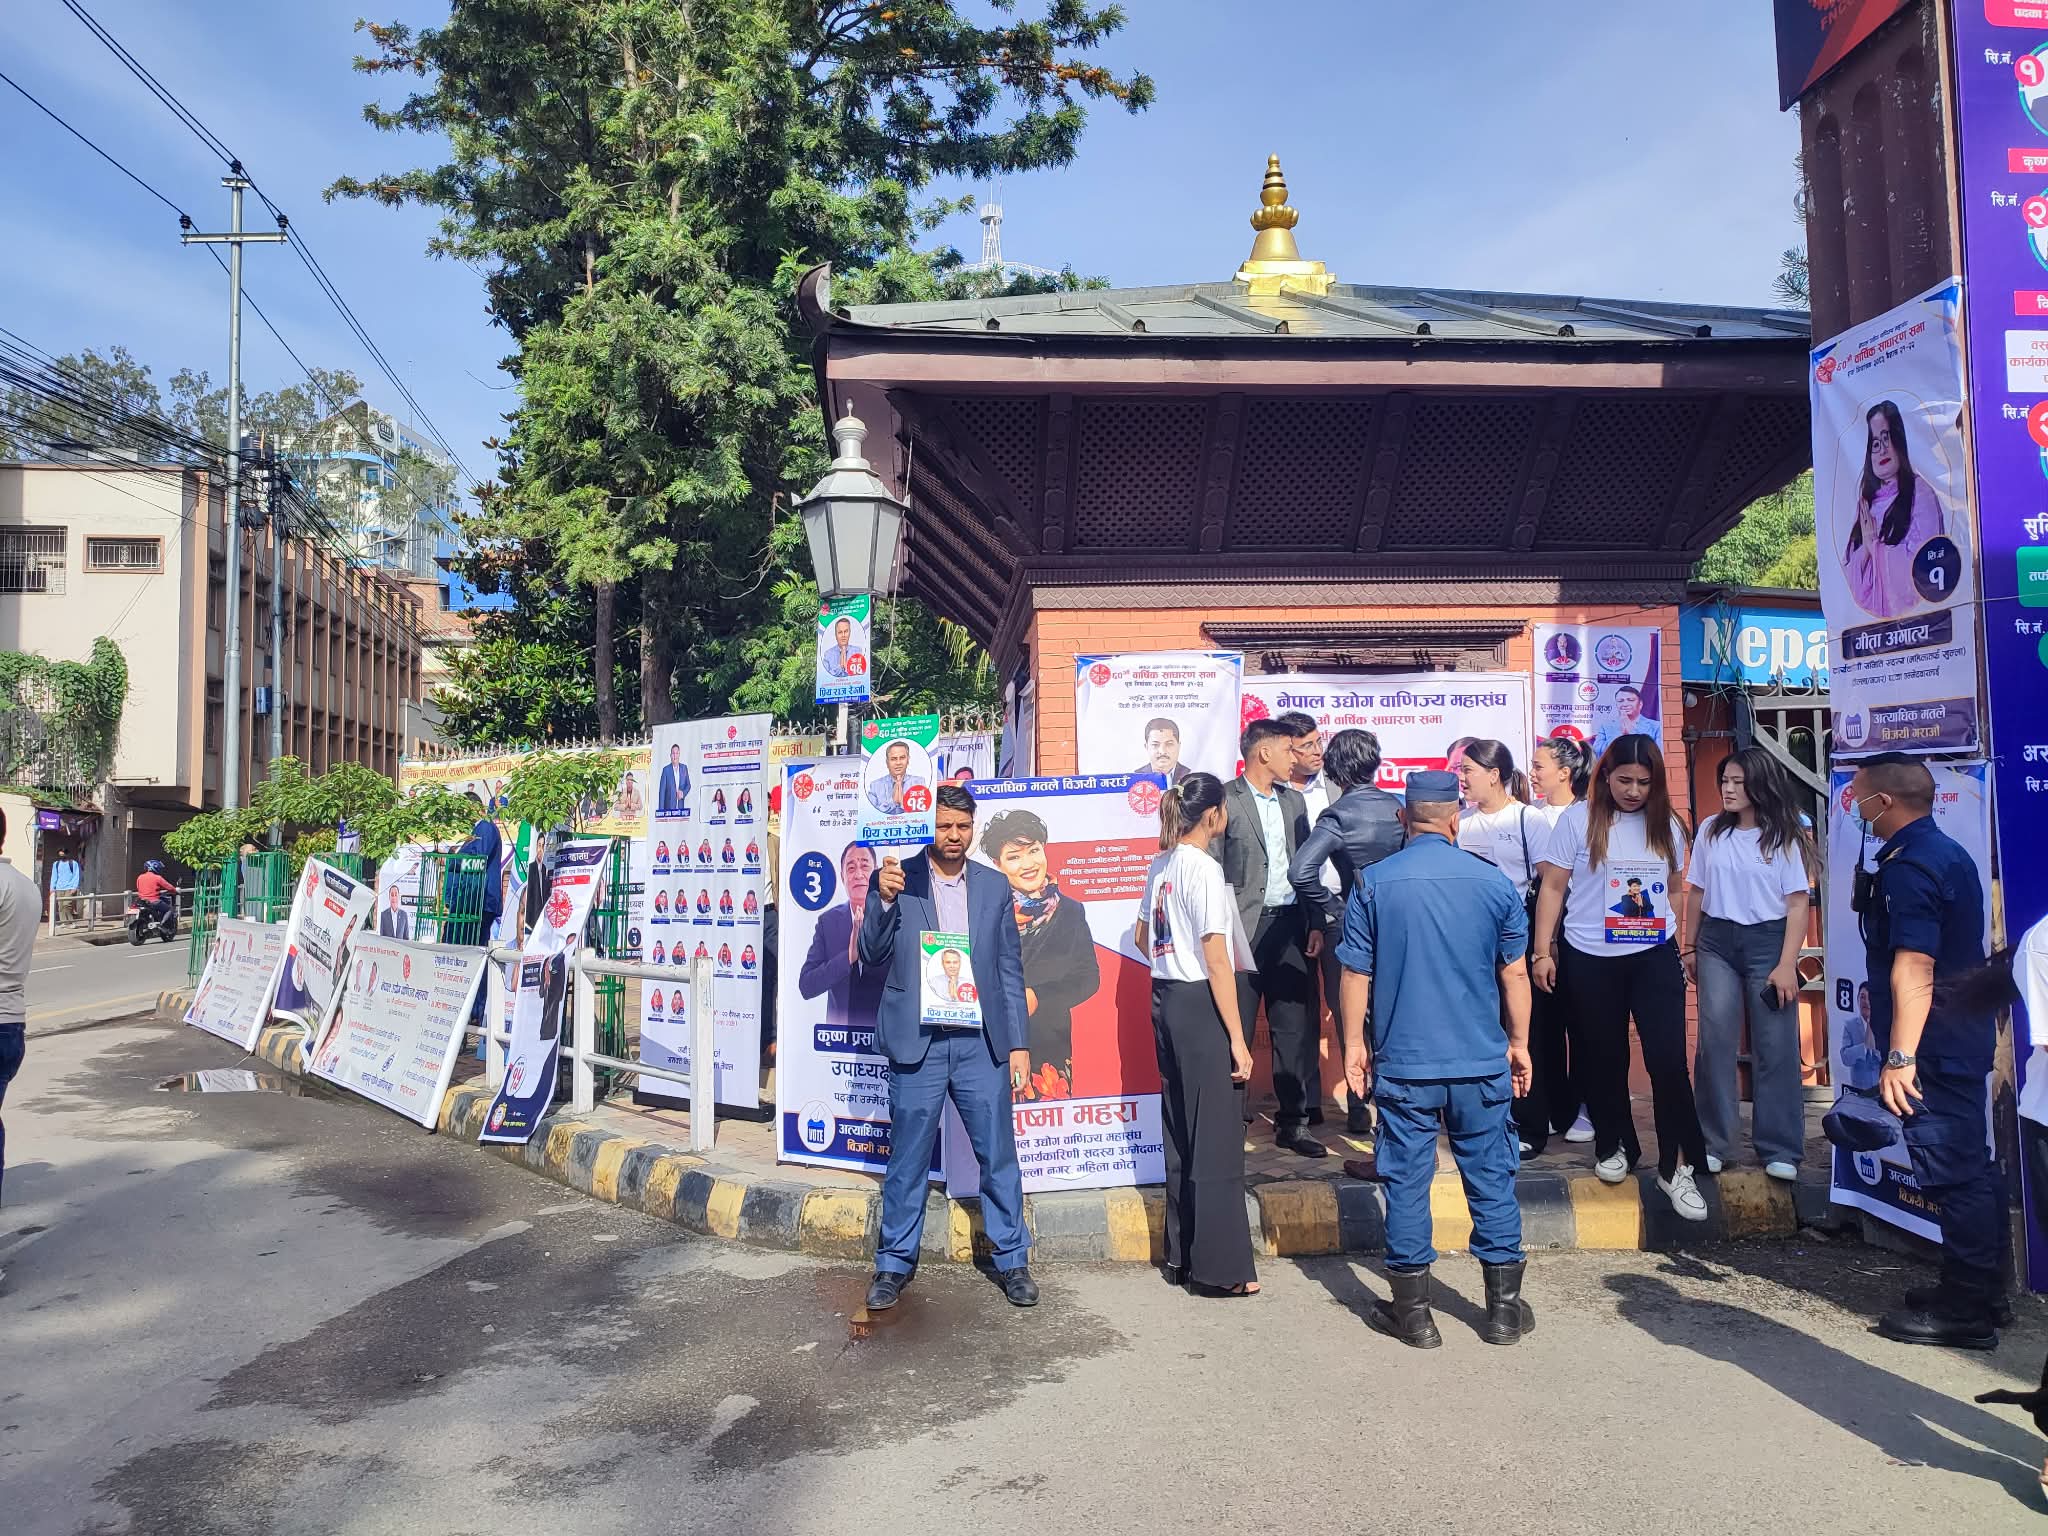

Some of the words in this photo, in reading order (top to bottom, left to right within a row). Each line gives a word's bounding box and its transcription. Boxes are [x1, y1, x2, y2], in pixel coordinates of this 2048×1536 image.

[1877, 331, 1907, 353] साधारण
[1909, 321, 1926, 337] सभा
[1929, 566, 1945, 591] १
[1855, 630, 1881, 653] गीता
[1132, 669, 1159, 680] वार्षिक
[1161, 671, 1196, 680] साधारण
[1198, 671, 1217, 680] सभा
[1276, 691, 1325, 709] नेपाल
[1330, 691, 1375, 708] उद्योग
[1380, 690, 1446, 708] वाणिज्य
[1450, 692, 1508, 707] महासंघ
[1333, 713, 1368, 726] वार्षिक
[1371, 714, 1416, 725] साधारण
[1419, 714, 1443, 725] सभा
[834, 779, 859, 790] वार्षिक
[971, 781, 1027, 795] अत्याधिक
[1030, 778, 1059, 791] मतले
[1062, 776, 1097, 790] विजयी
[907, 797, 927, 811] १६
[862, 826, 880, 839] प्रिय
[883, 827, 902, 838] राज
[904, 823, 928, 836] रेग्मी
[461, 858, 486, 871] KMC
[803, 871, 822, 904] ३
[816, 1029, 848, 1046] कृष्ण
[834, 1092, 857, 1104] पदका
[1073, 1101, 1139, 1126] महरा
[808, 1129, 825, 1144] VOTE
[838, 1123, 884, 1137] अत्याधिक
[847, 1139, 874, 1154] विजयी
[1033, 1134, 1061, 1149] उद्योग
[1063, 1132, 1102, 1146] वाणिज्य
[1105, 1129, 1142, 1144] महासंघ
[1020, 1146, 1080, 1165] कार्यकारिणी
[1082, 1146, 1114, 1161] सदस्य
[1117, 1142, 1164, 1160] उम्मेदवार
[1076, 1161, 1110, 1177] महिला
[1112, 1159, 1137, 1174] कोटा
